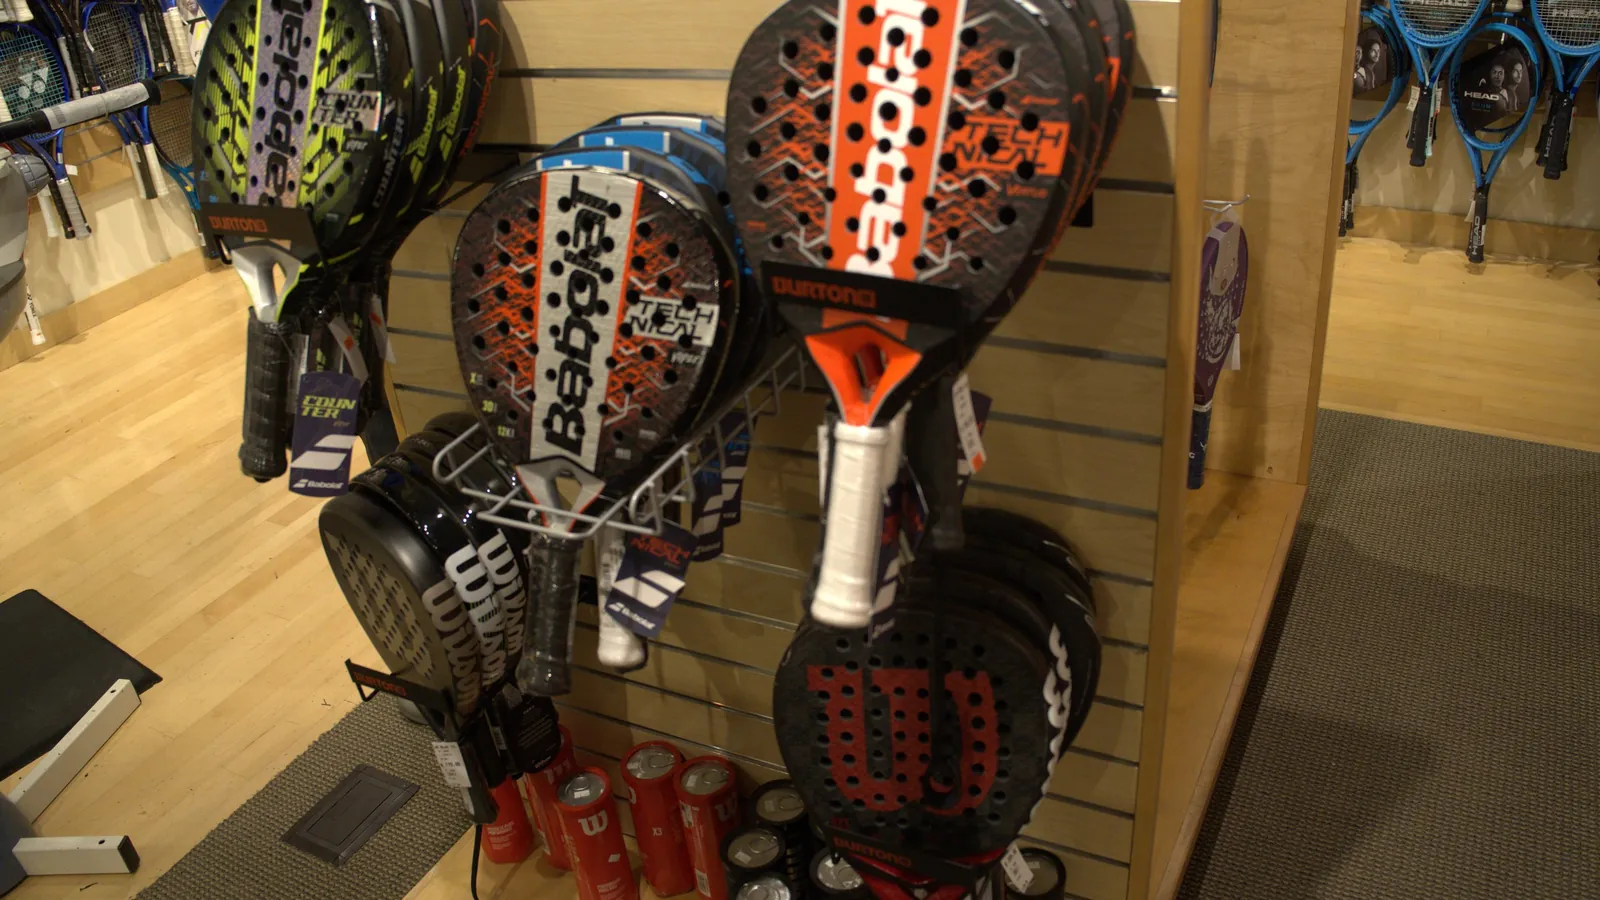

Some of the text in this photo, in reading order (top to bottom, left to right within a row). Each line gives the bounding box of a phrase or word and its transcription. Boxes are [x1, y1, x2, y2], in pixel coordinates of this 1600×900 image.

[1464, 90, 1500, 101] HEAD
[965, 123, 1063, 148] TECH
[1471, 215, 1481, 256] HEAD
[545, 174, 609, 456] Babolat
[639, 300, 714, 324] TECH
[302, 395, 357, 410] COUN
[301, 406, 341, 419] TER
[307, 480, 344, 489] Babolat
